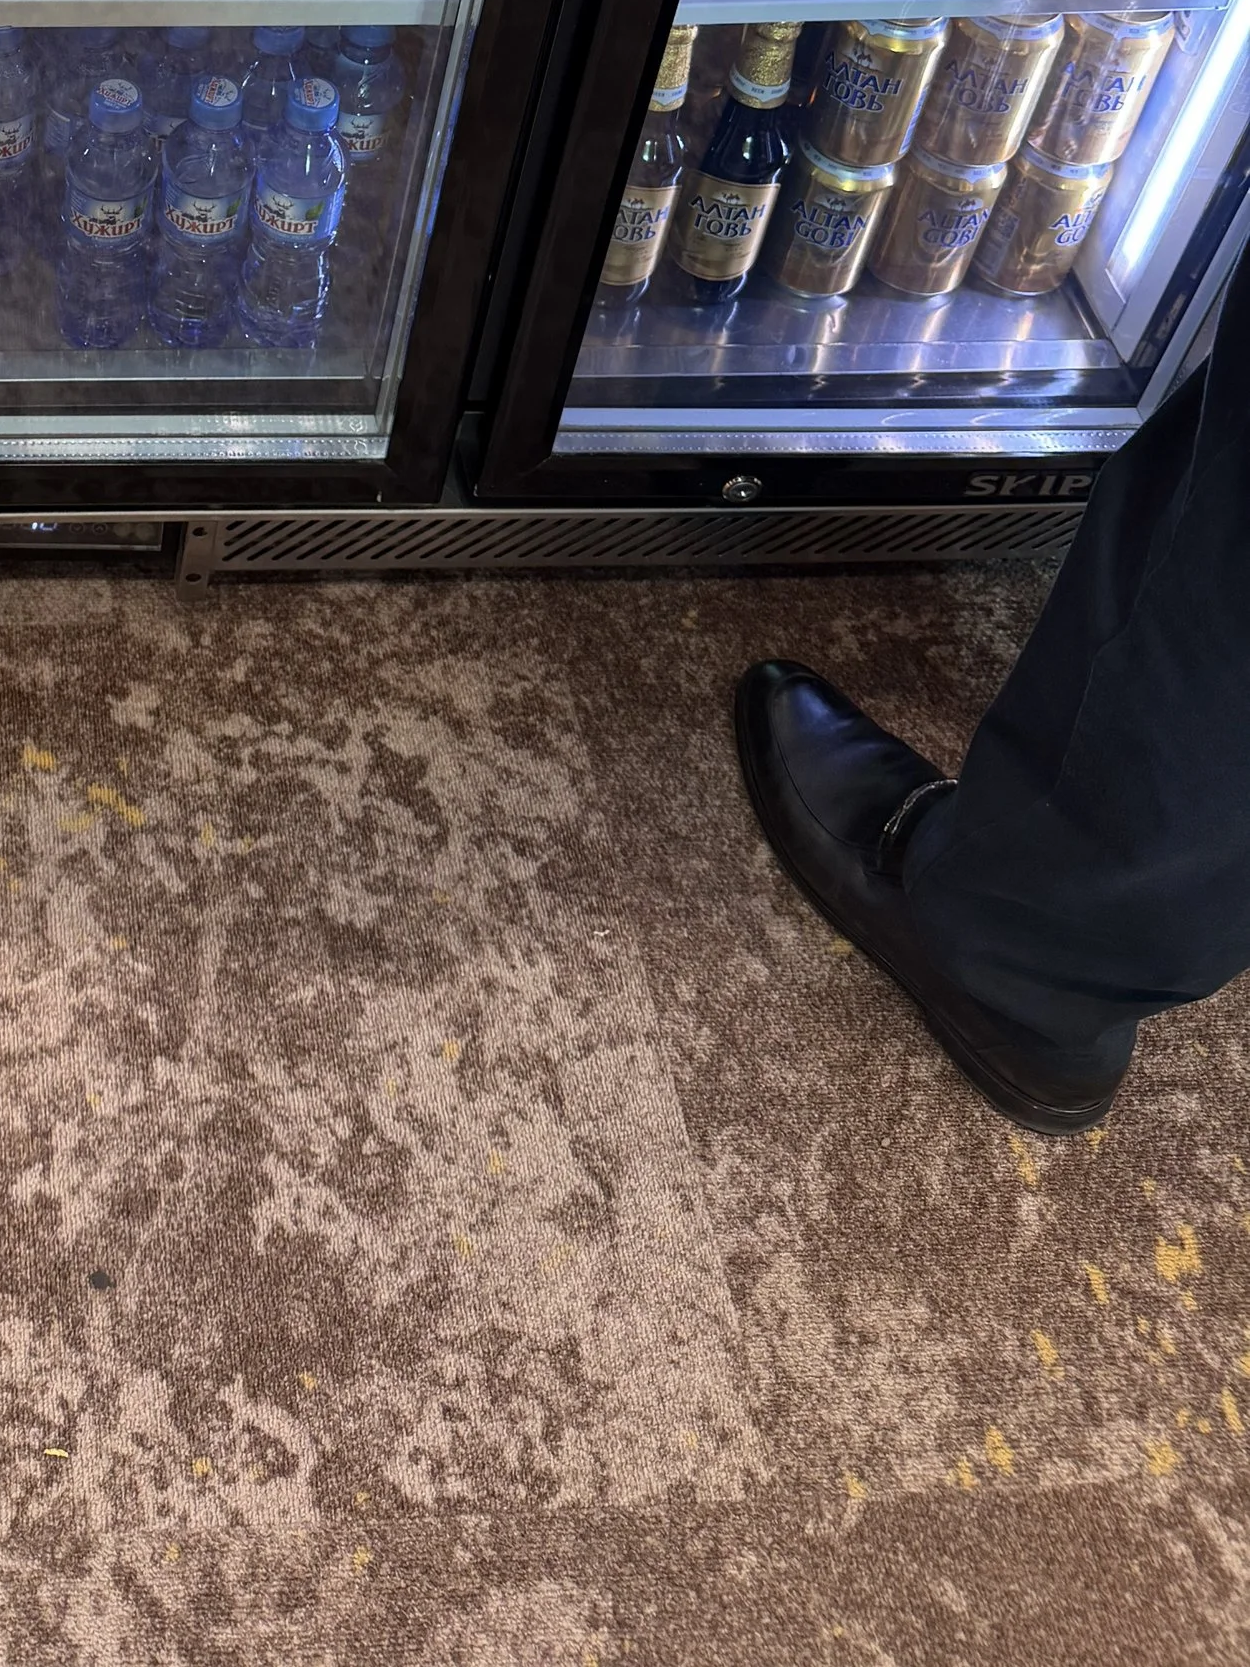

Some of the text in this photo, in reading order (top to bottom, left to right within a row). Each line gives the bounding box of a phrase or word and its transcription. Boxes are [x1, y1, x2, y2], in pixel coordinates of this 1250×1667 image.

[690, 194, 766, 219] АЛТАН
[70, 209, 144, 237] Хужирт
[164, 204, 237, 235] Хужирт
[693, 212, 753, 239] ГОВЬ
[1051, 210, 1093, 231] ALT
[614, 225, 656, 241] ОВЬ
[794, 221, 855, 249] GOBI
[921, 227, 978, 248] GOBI
[963, 474, 1093, 497] SKIP
